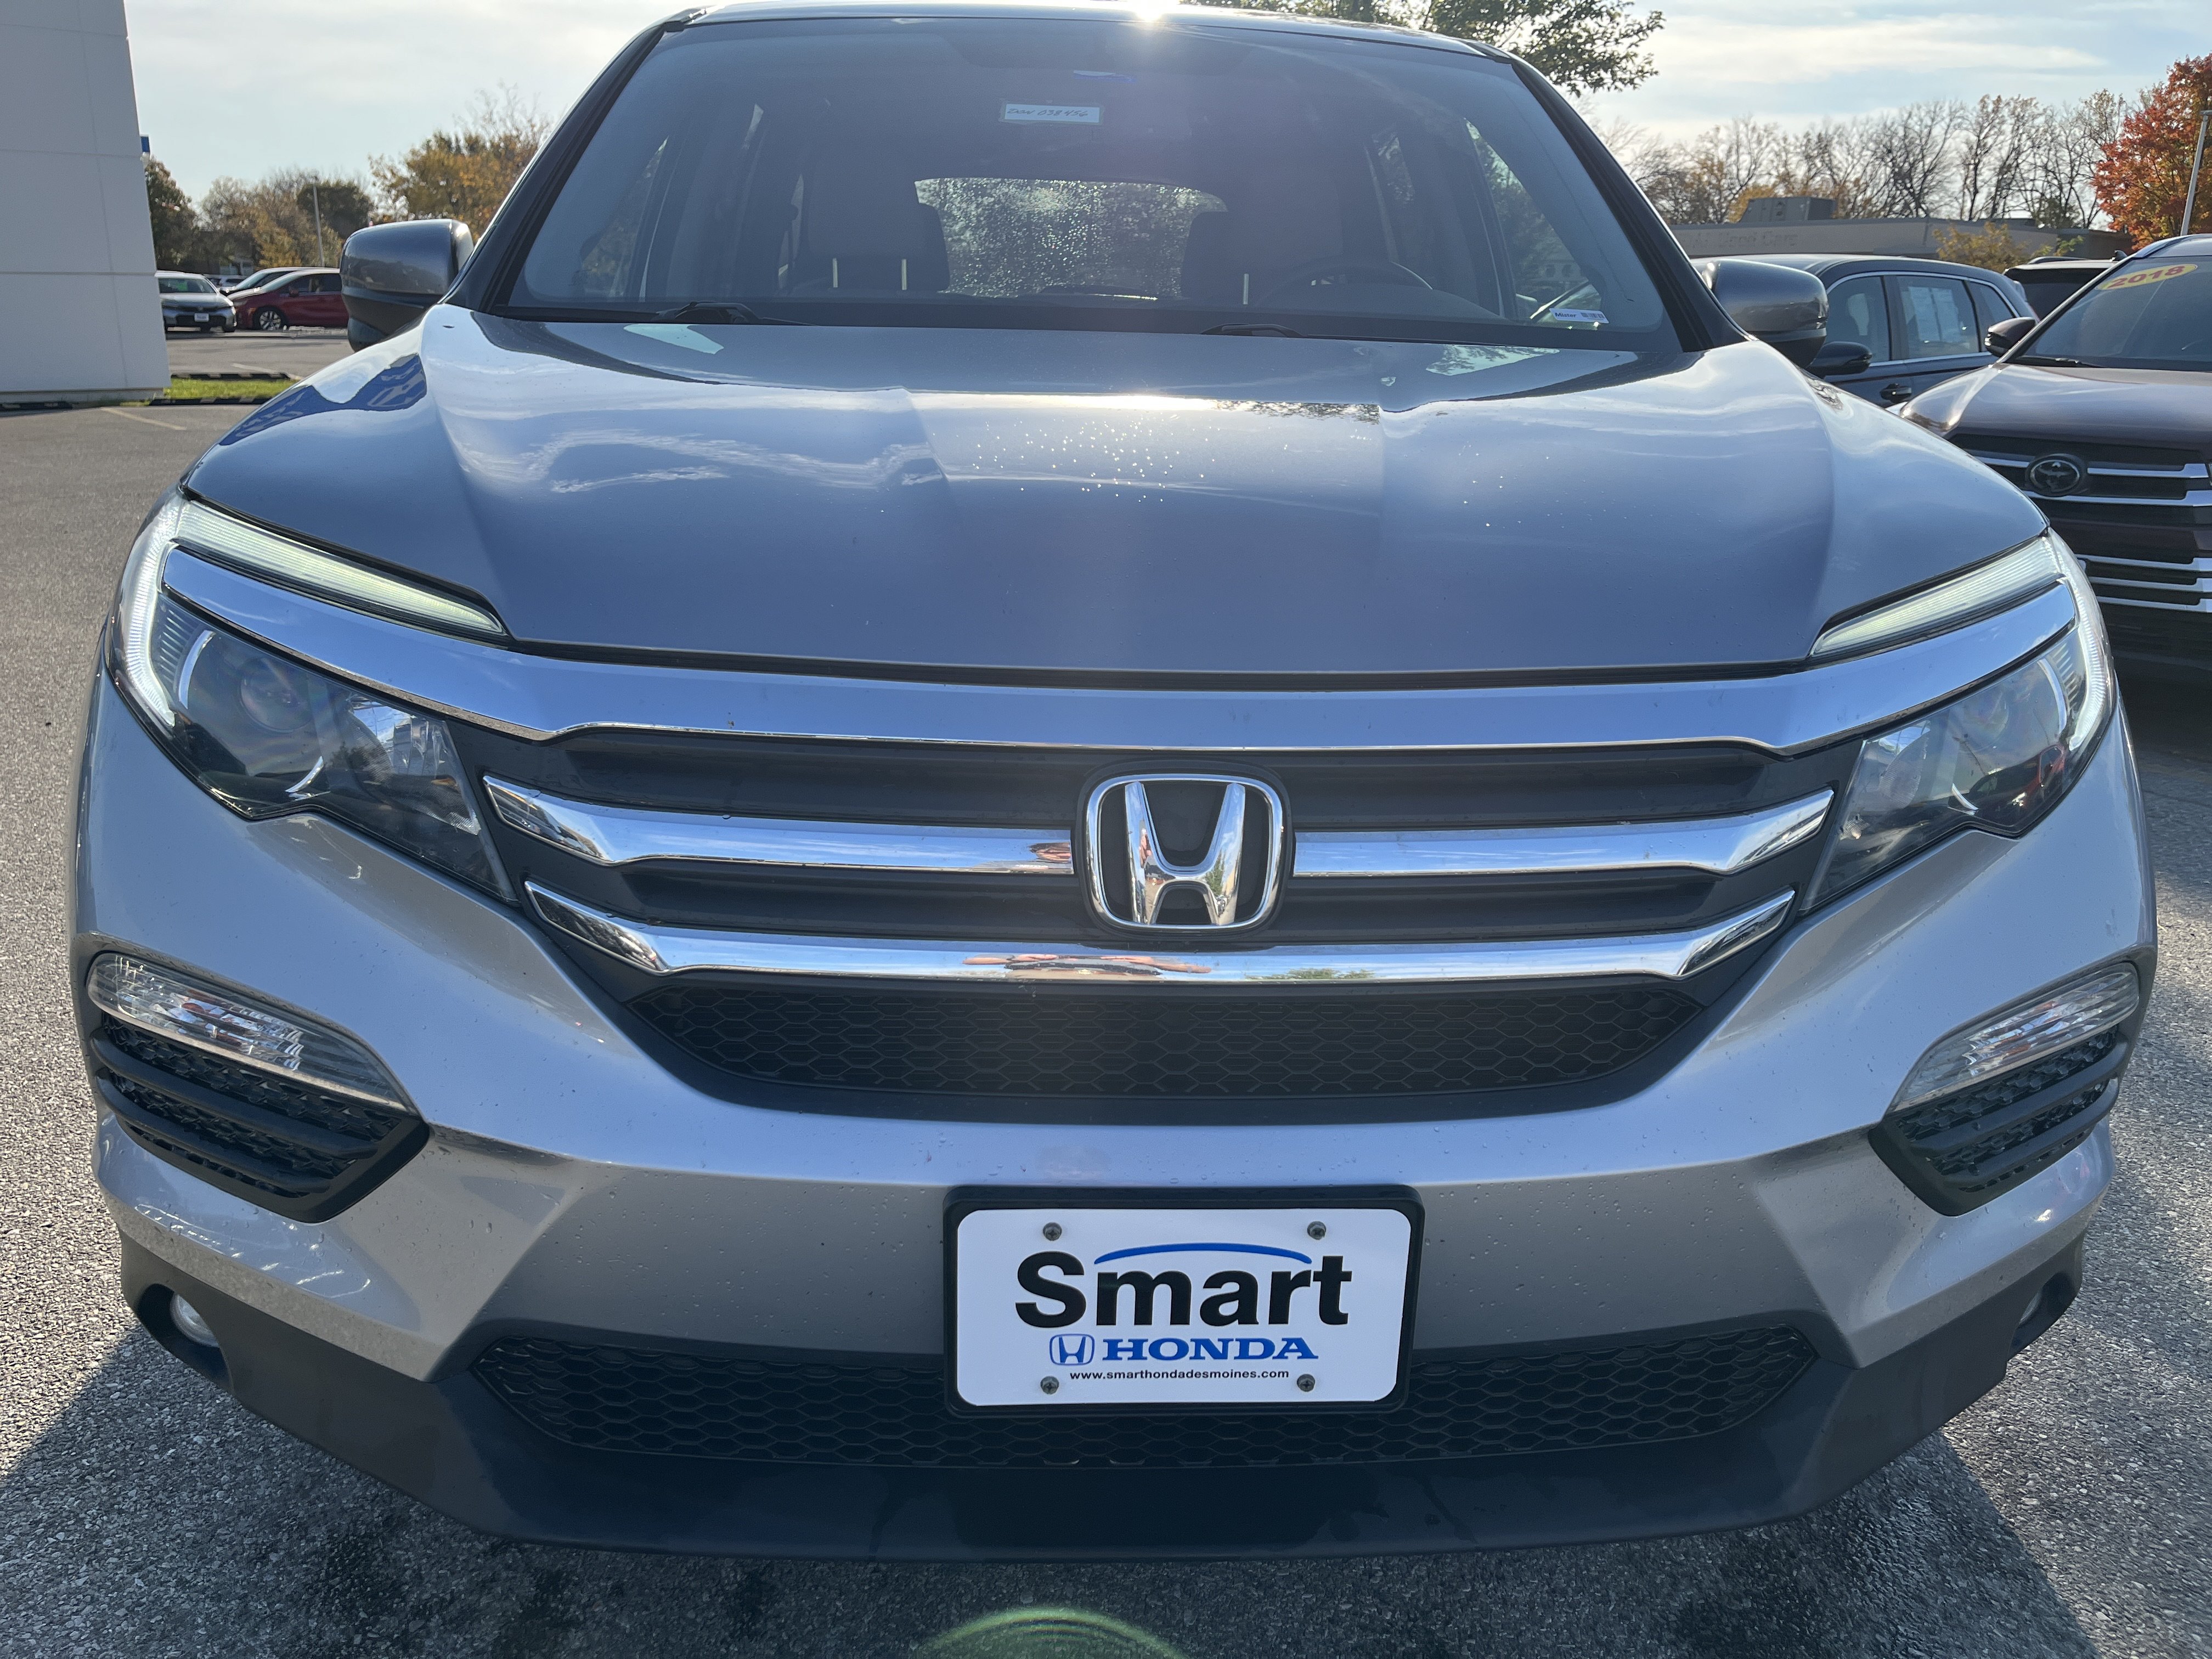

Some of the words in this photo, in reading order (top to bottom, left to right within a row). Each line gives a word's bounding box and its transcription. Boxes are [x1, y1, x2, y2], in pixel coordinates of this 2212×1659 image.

[2107, 266, 2186, 289] 2018
[1014, 1250, 1352, 1328] Smart
[1102, 1337, 1318, 1361] HONDA
[1069, 1369, 1290, 1379] www.smarthondadesmoines.com
